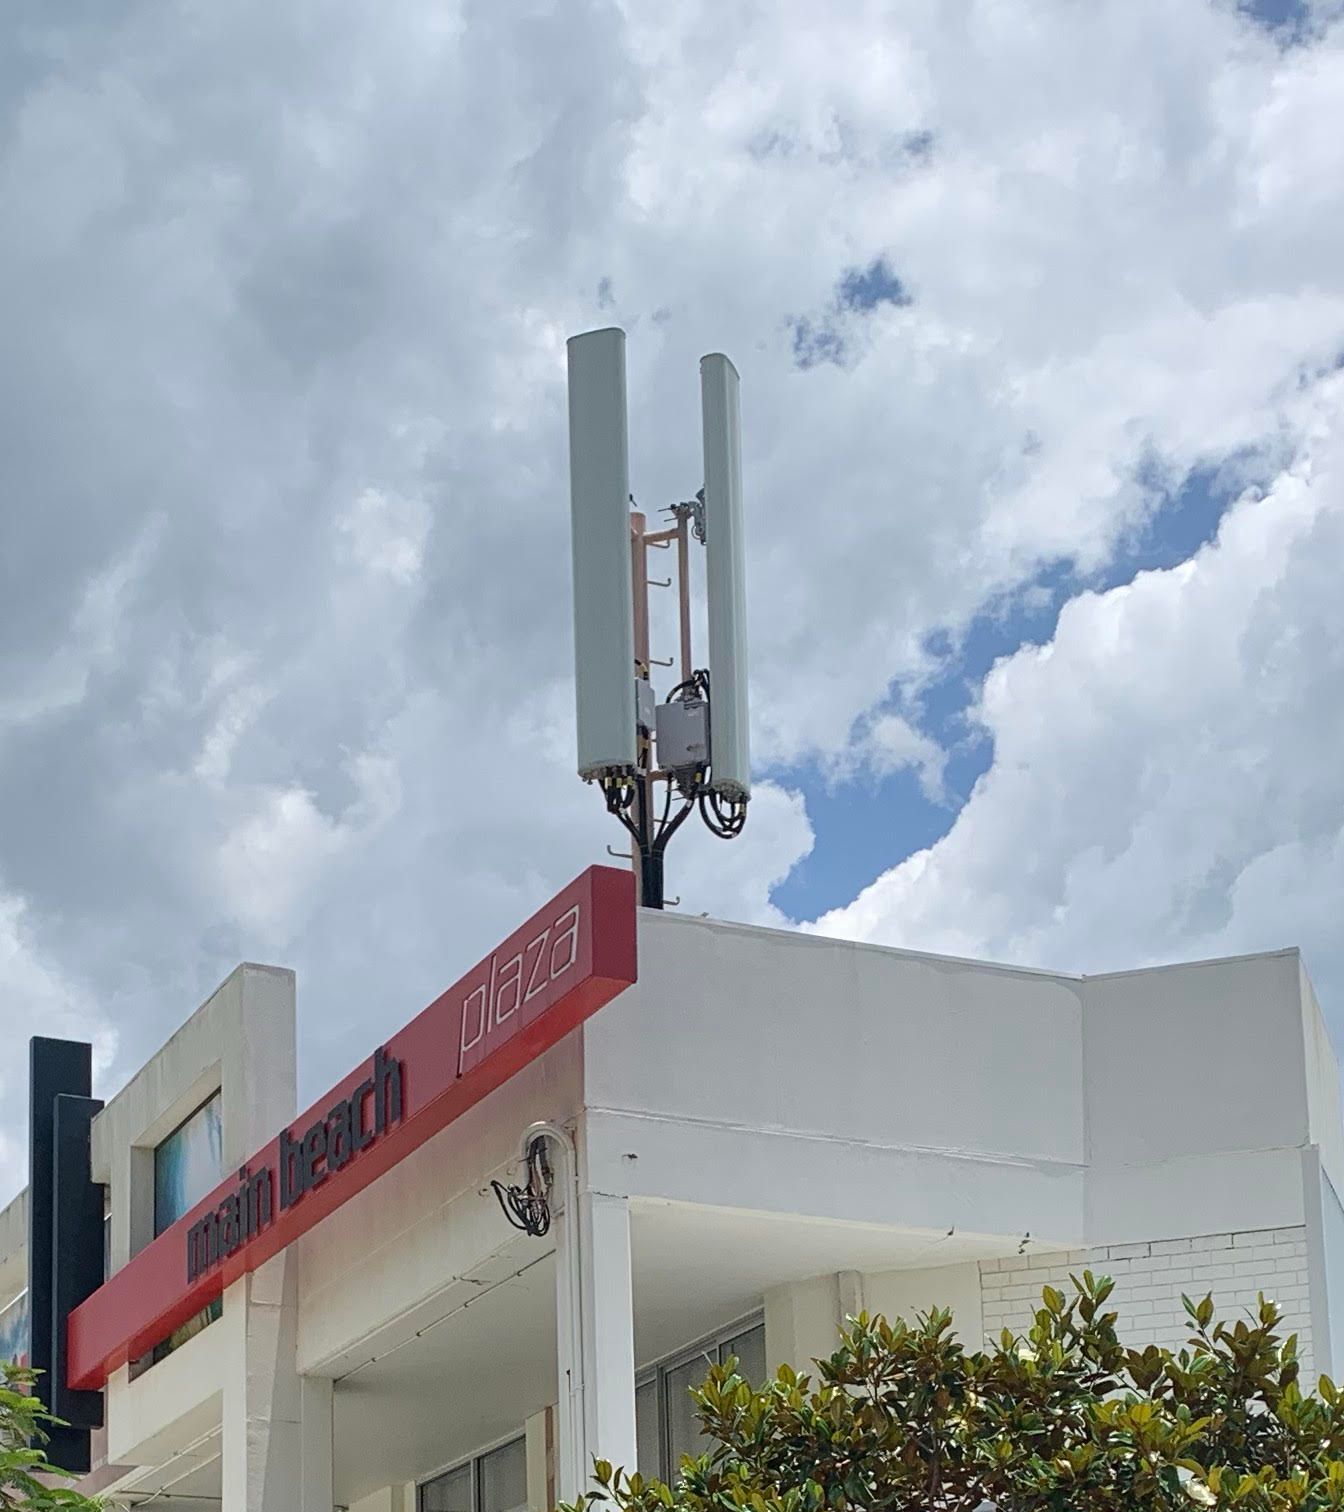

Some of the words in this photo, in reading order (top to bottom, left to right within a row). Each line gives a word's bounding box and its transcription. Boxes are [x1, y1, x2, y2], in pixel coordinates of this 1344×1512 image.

[187, 1165, 274, 1286] main
[279, 1046, 405, 1212] beach
[456, 903, 580, 1079] plaza
